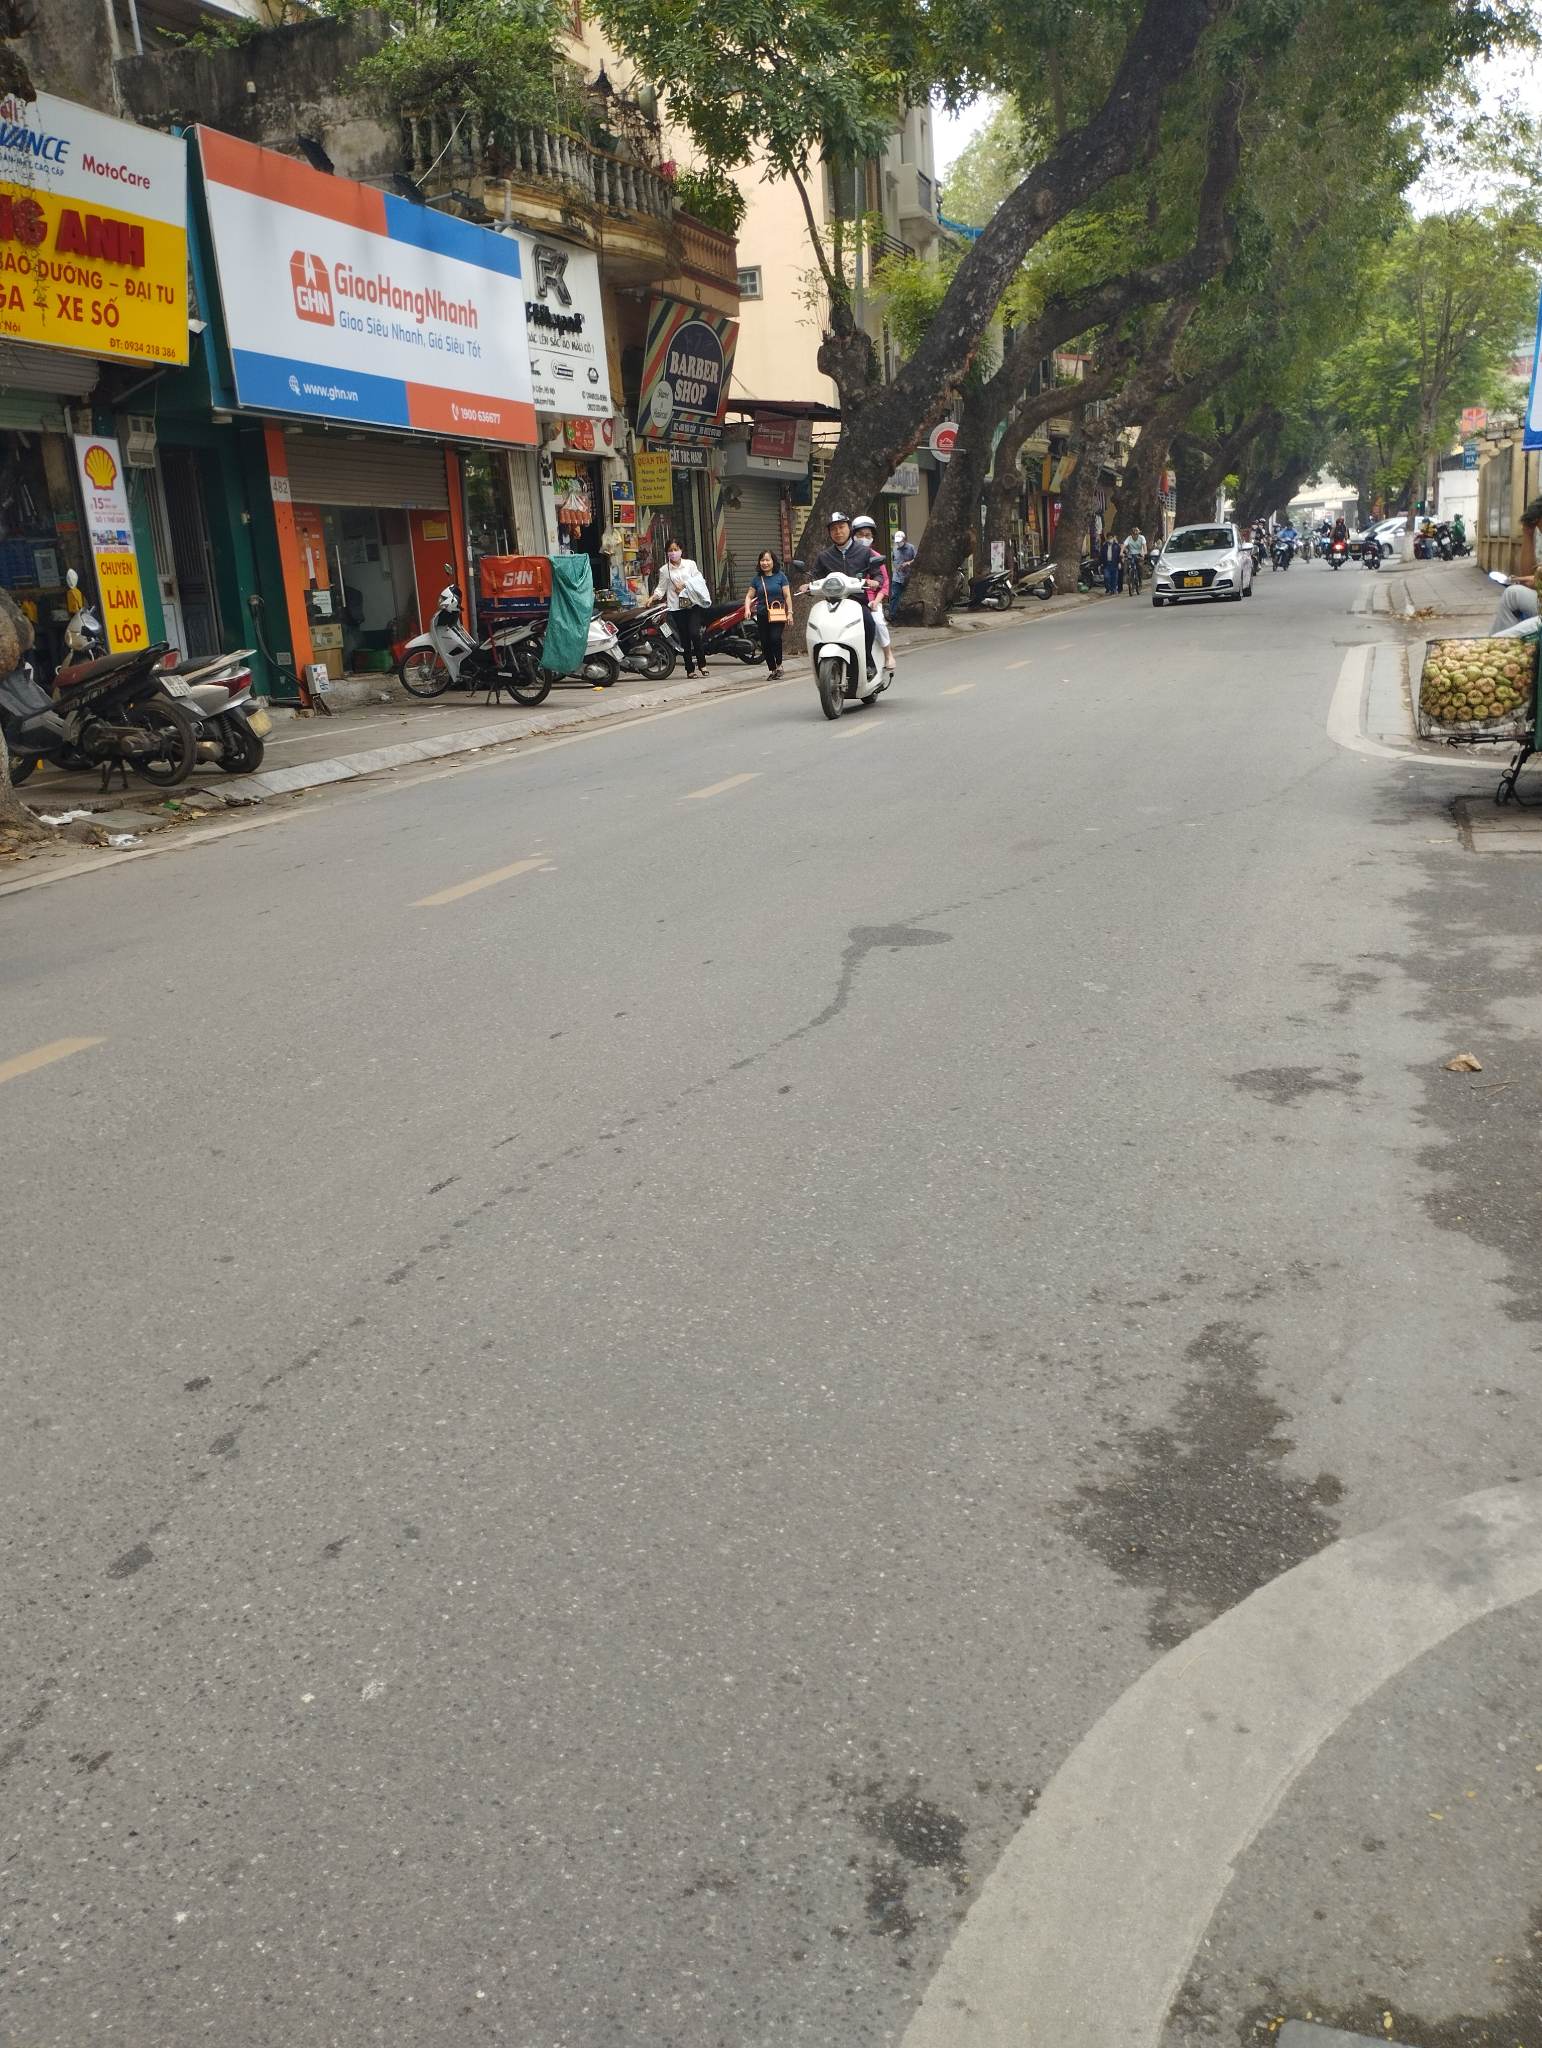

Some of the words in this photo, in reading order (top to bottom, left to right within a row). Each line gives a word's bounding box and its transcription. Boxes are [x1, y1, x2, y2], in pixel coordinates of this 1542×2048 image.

[82, 153, 151, 190] MotoCare
[55, 208, 145, 269] ANH
[532, 244, 573, 306] R
[124, 277, 151, 303] ĐẠI
[296, 285, 330, 317] GHN
[334, 262, 478, 330] GiaoHangNhanh
[56, 292, 84, 323] XE
[91, 296, 120, 329] SỐ
[339, 310, 364, 332] Giao
[367, 316, 389, 339] Siêu
[428, 331, 444, 350] Giá
[446, 335, 465, 355] Siêu
[467, 339, 482, 359] Tốt
[669, 351, 719, 384] BARBER
[303, 382, 359, 402] www.ghn.vn
[674, 379, 708, 406] SHOP
[460, 407, 477, 420] 1900
[92, 497, 104, 510] 15
[101, 560, 133, 576] CHUYÊN
[502, 570, 533, 587] GHN
[107, 585, 139, 609] LÀM
[114, 617, 142, 644] LỐP
